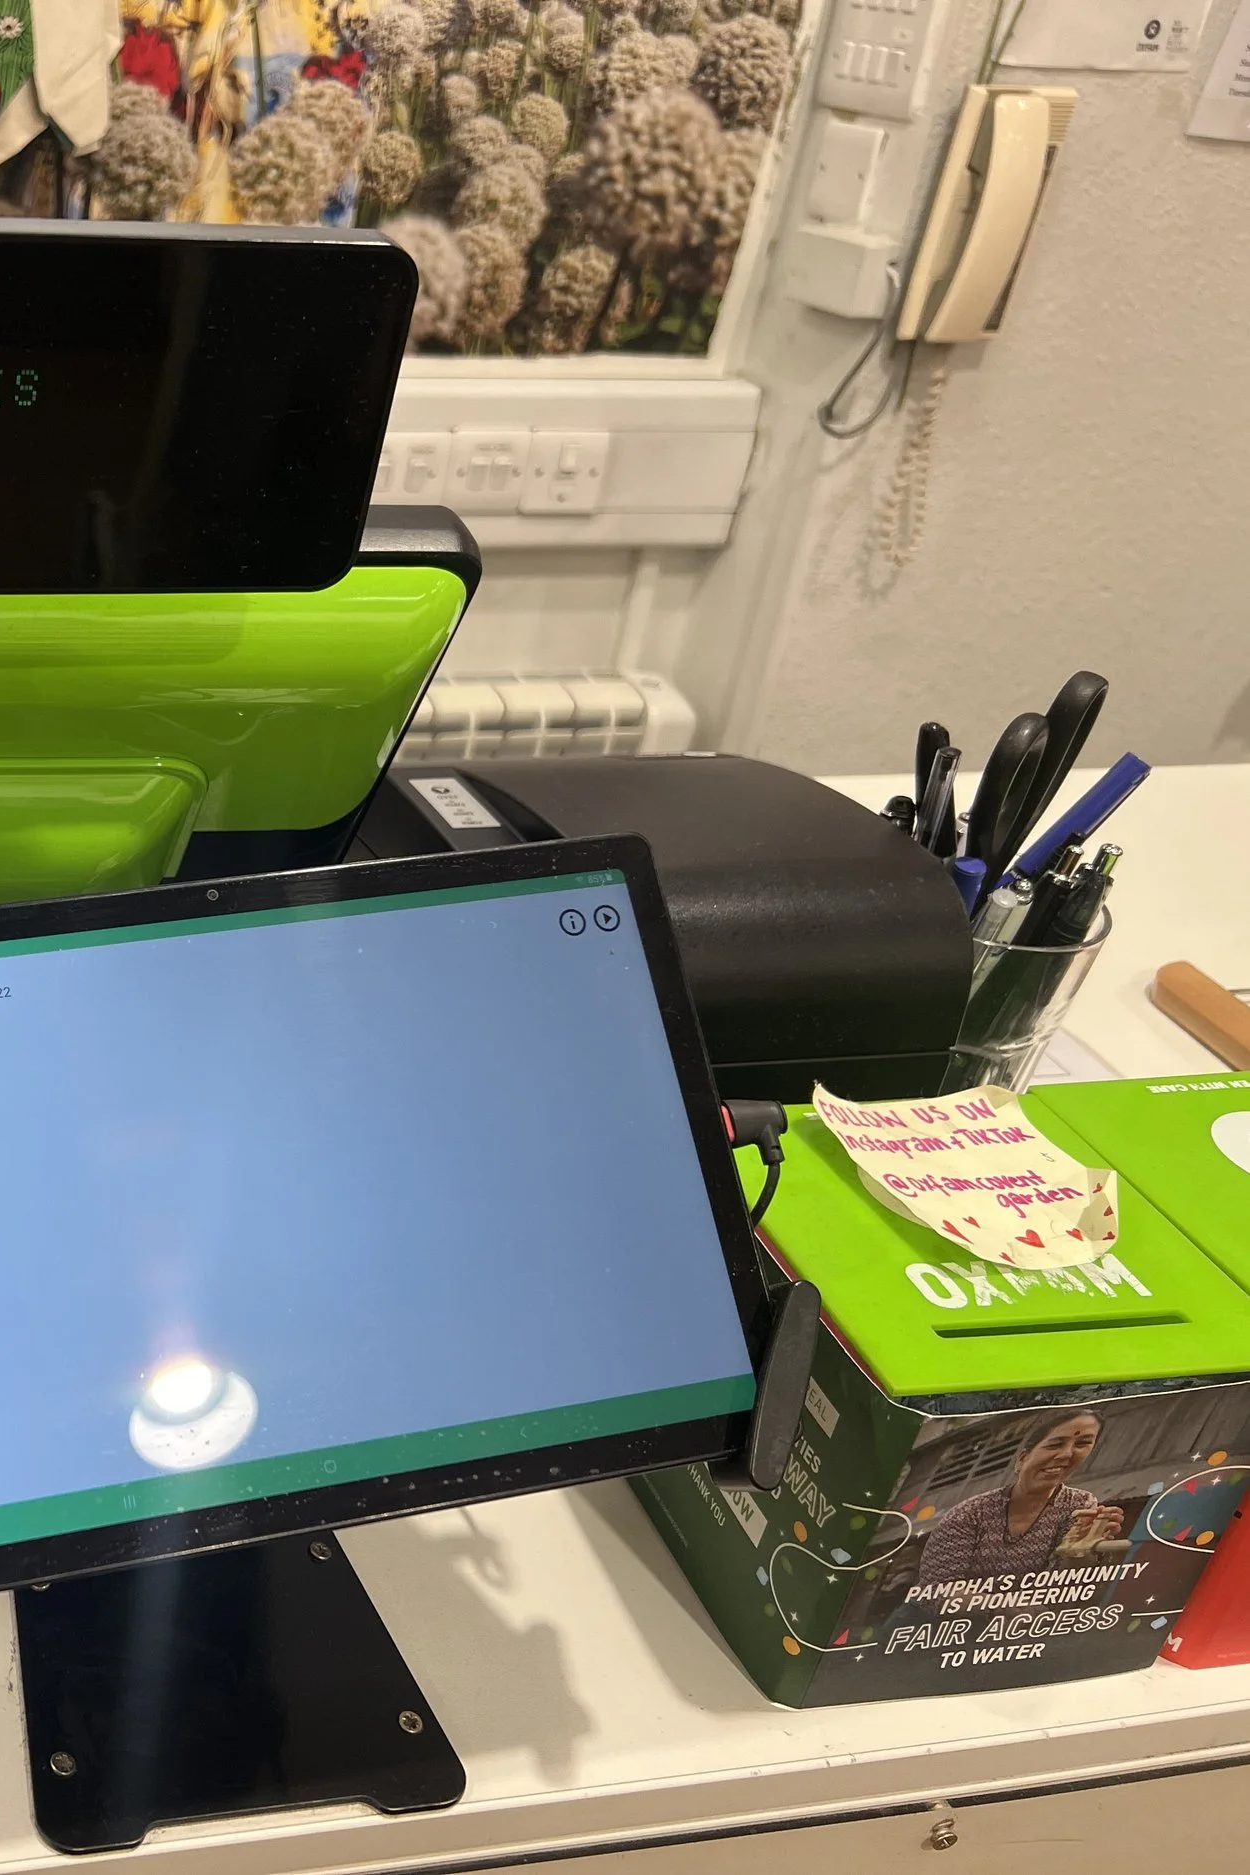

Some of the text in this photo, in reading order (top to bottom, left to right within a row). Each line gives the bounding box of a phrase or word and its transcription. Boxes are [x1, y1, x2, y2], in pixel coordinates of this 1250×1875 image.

[818, 1098, 997, 1128] FOLLOW US ON
[996, 1187, 1084, 1218] garden
[808, 1388, 827, 1422] EAL
[709, 1502, 726, 1527] YOU
[904, 1562, 1150, 1603] PAMPHA'S COMMUNITY
[940, 1584, 1096, 1615] IS PIONEERING
[884, 1618, 972, 1655] FAIR
[976, 1603, 1124, 1643] ACCESS
[940, 1643, 1046, 1669] TO WATER
